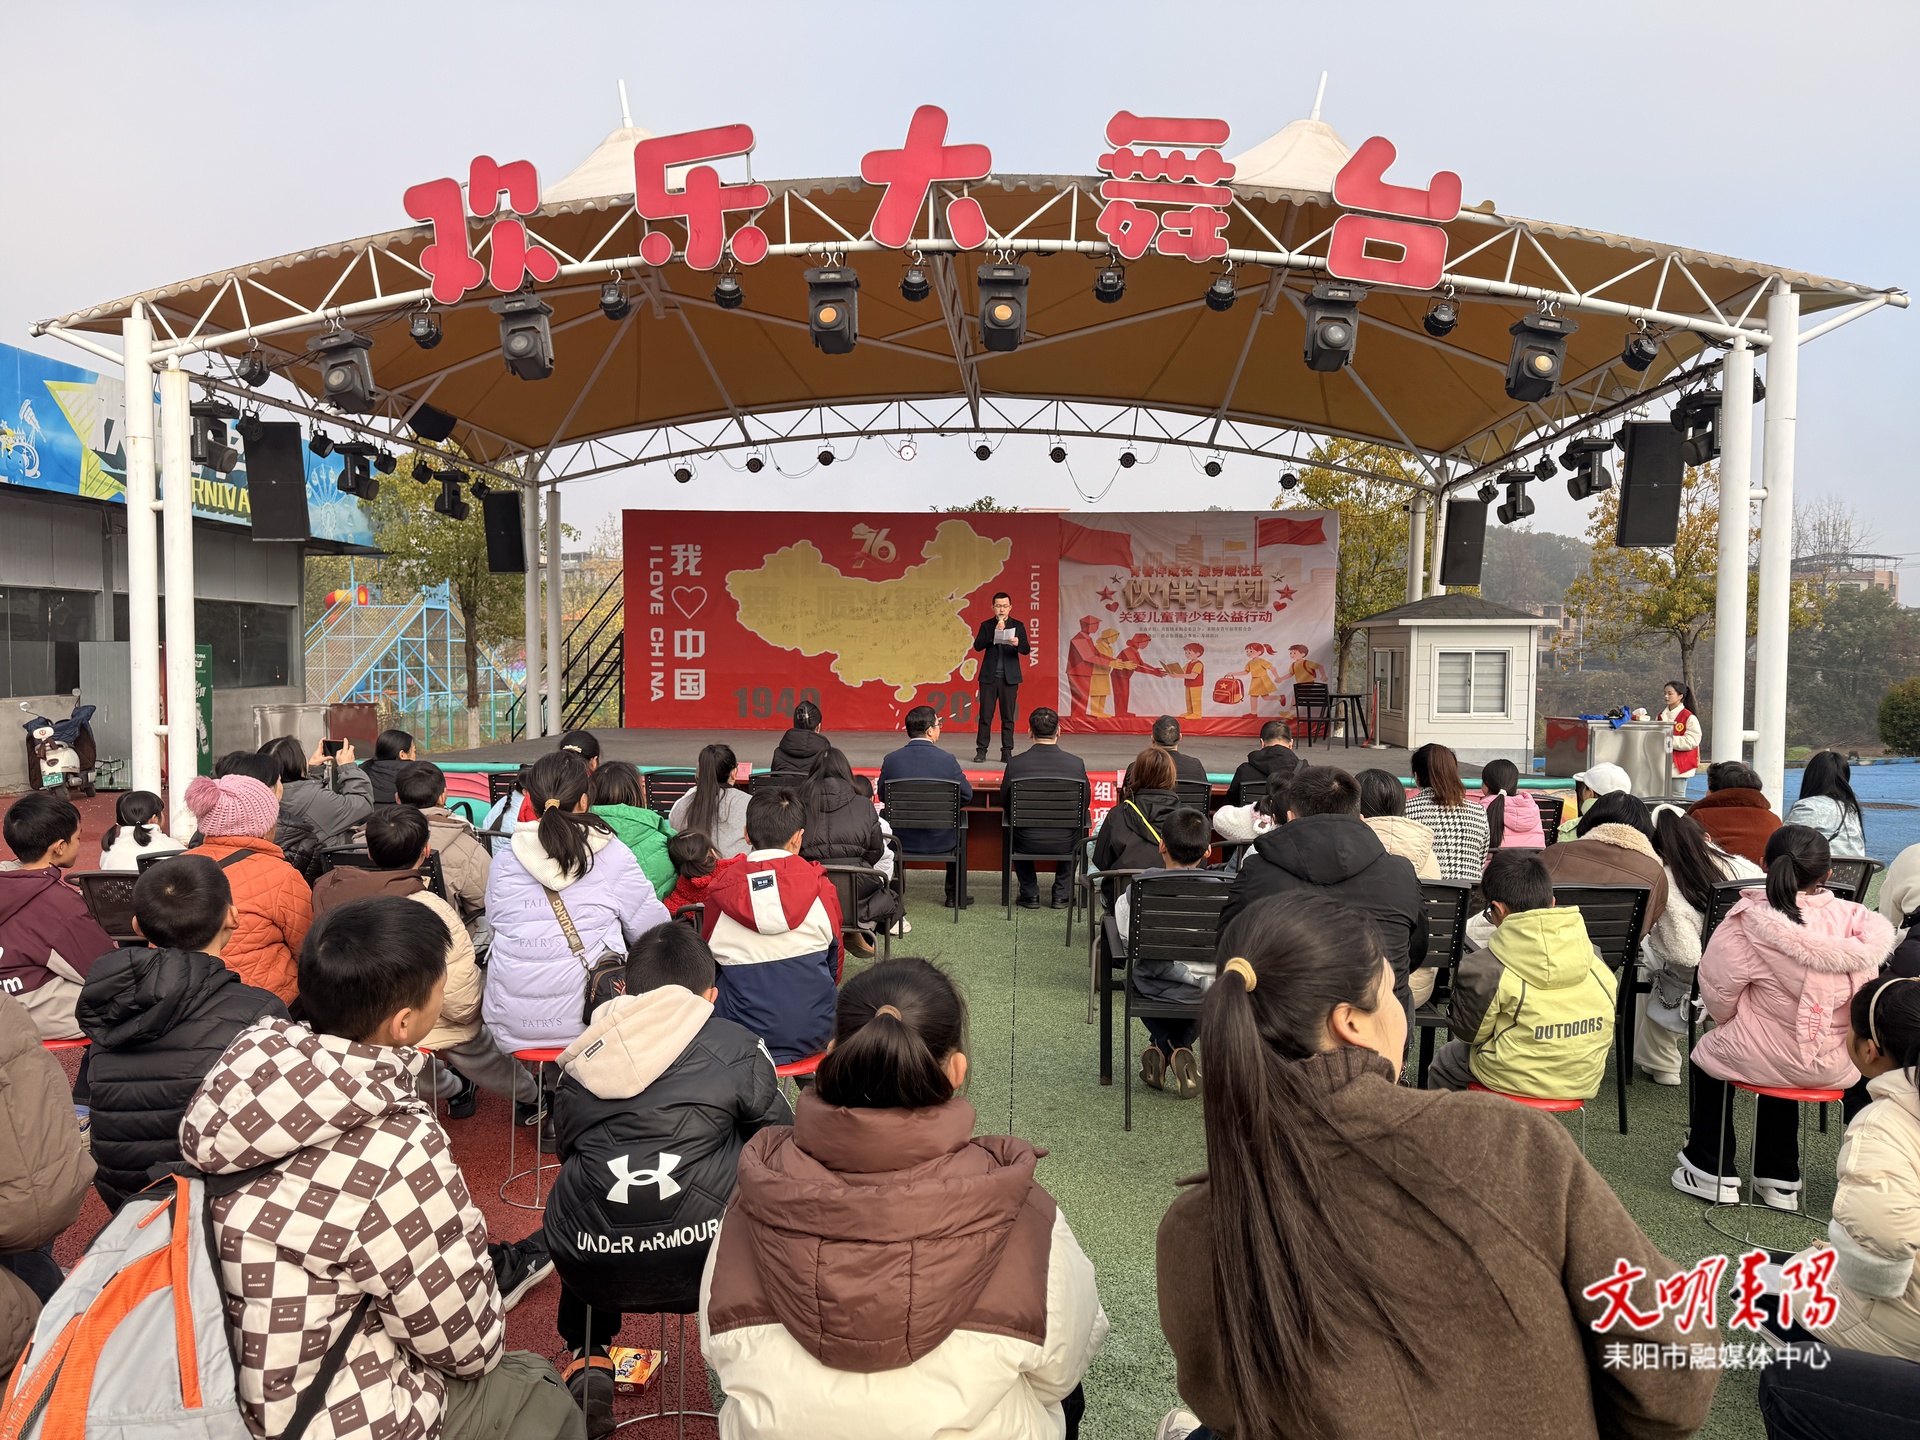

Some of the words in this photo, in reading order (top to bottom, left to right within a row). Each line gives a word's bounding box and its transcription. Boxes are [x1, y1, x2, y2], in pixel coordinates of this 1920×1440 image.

[403, 104, 1463, 306] 欢乐大舞台
[670, 543, 703, 577] 我
[852, 525, 897, 569] 76
[650, 557, 664, 615] LOVE
[1030, 572, 1041, 611] LOVE
[1122, 577, 1271, 610] 伙伴计划
[1118, 610, 1273, 624] 关爱儿童青少年公益行动
[1029, 617, 1040, 668] CHINA
[650, 627, 665, 702] CHINA
[674, 628, 706, 701] 中国
[1094, 781, 1112, 802] 组
[551, 898, 577, 938] HUANG
[519, 937, 563, 949] FAIRYS
[521, 1017, 563, 1029] FAIRYS
[1534, 1016, 1603, 1041] OUTDOORS
[576, 1230, 635, 1254] UNDER
[638, 1218, 719, 1253] ARMOUR
